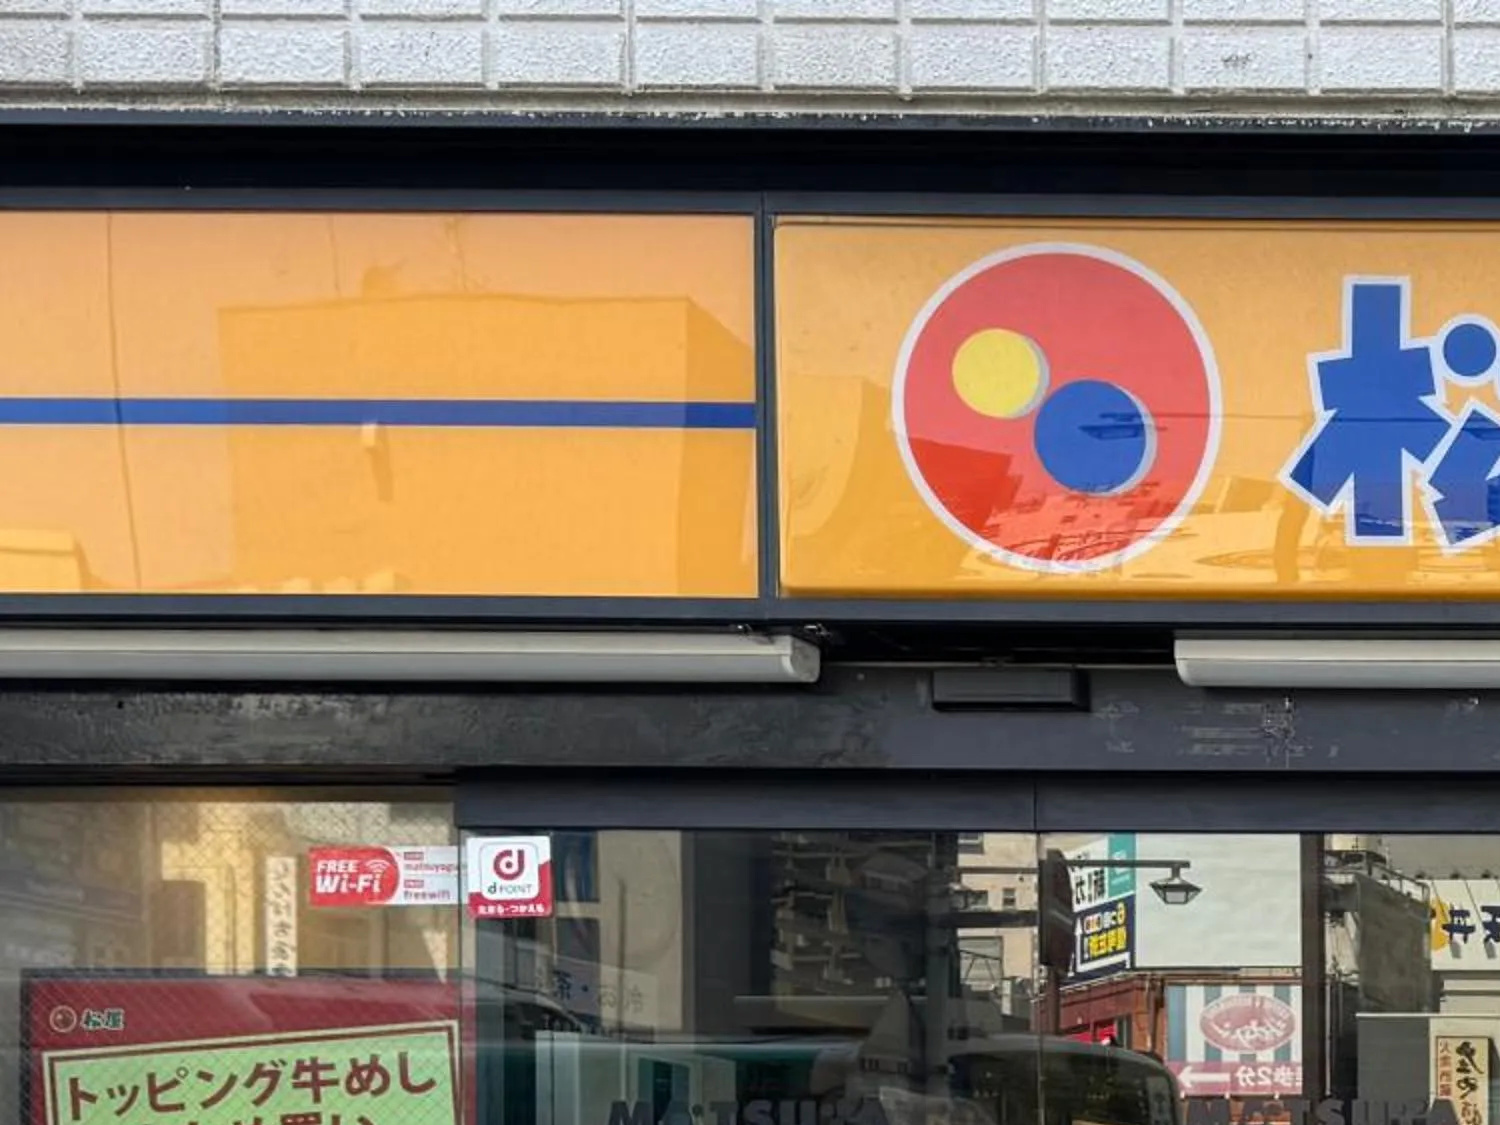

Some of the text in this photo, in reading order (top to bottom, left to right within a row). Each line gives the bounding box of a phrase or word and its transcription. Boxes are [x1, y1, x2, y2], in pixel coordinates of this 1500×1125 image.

[317, 860, 359, 873] FREE
[316, 873, 381, 893] Wi-Fi
[500, 886, 532, 894] POINT
[68, 1049, 438, 1121] トッピング牛めし
